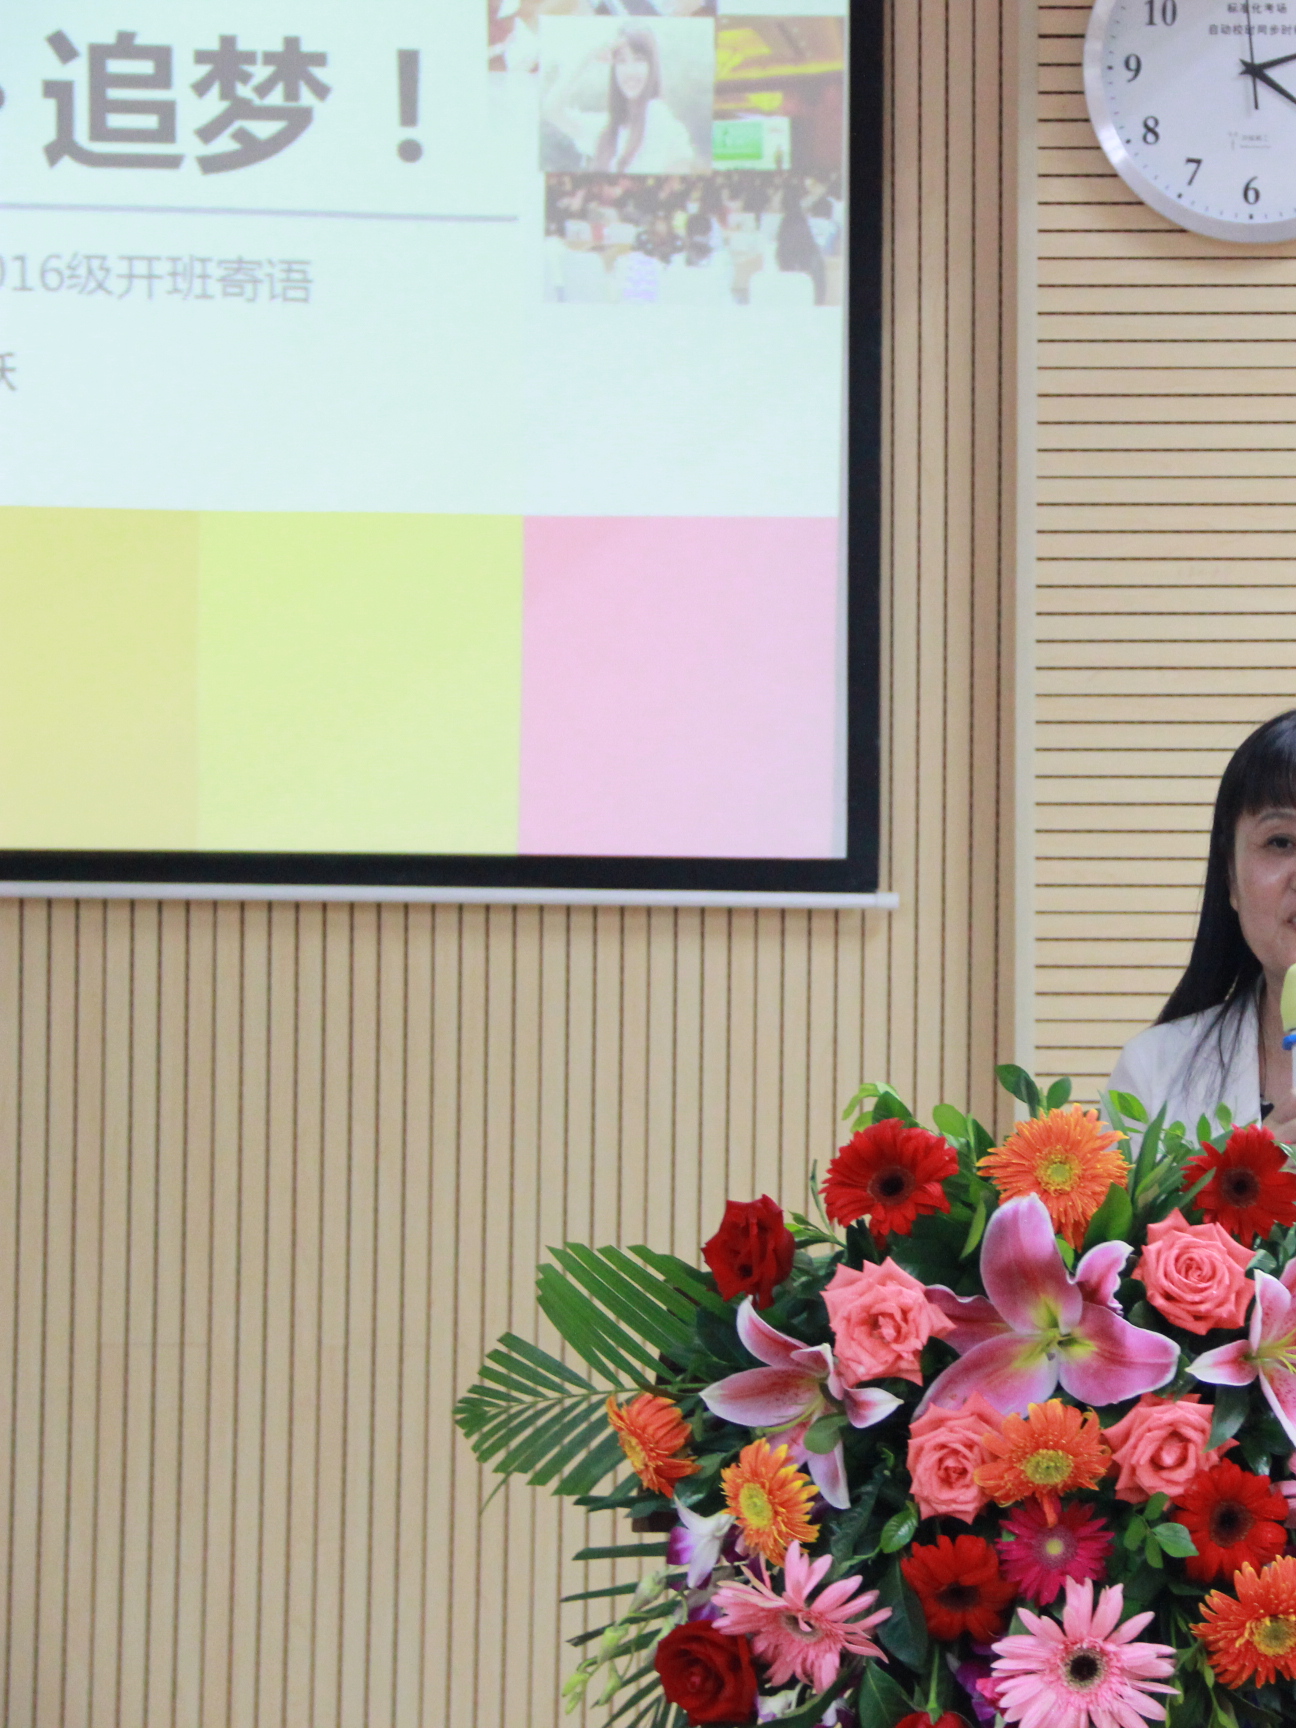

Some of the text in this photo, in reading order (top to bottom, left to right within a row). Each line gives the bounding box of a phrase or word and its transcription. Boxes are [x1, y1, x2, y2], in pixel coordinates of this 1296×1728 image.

[1145, 0, 1178, 27] 10
[1124, 53, 1142, 83] 9
[1142, 115, 1160, 145] 8
[1185, 157, 1203, 186] 7
[1243, 176, 1260, 205] 6
